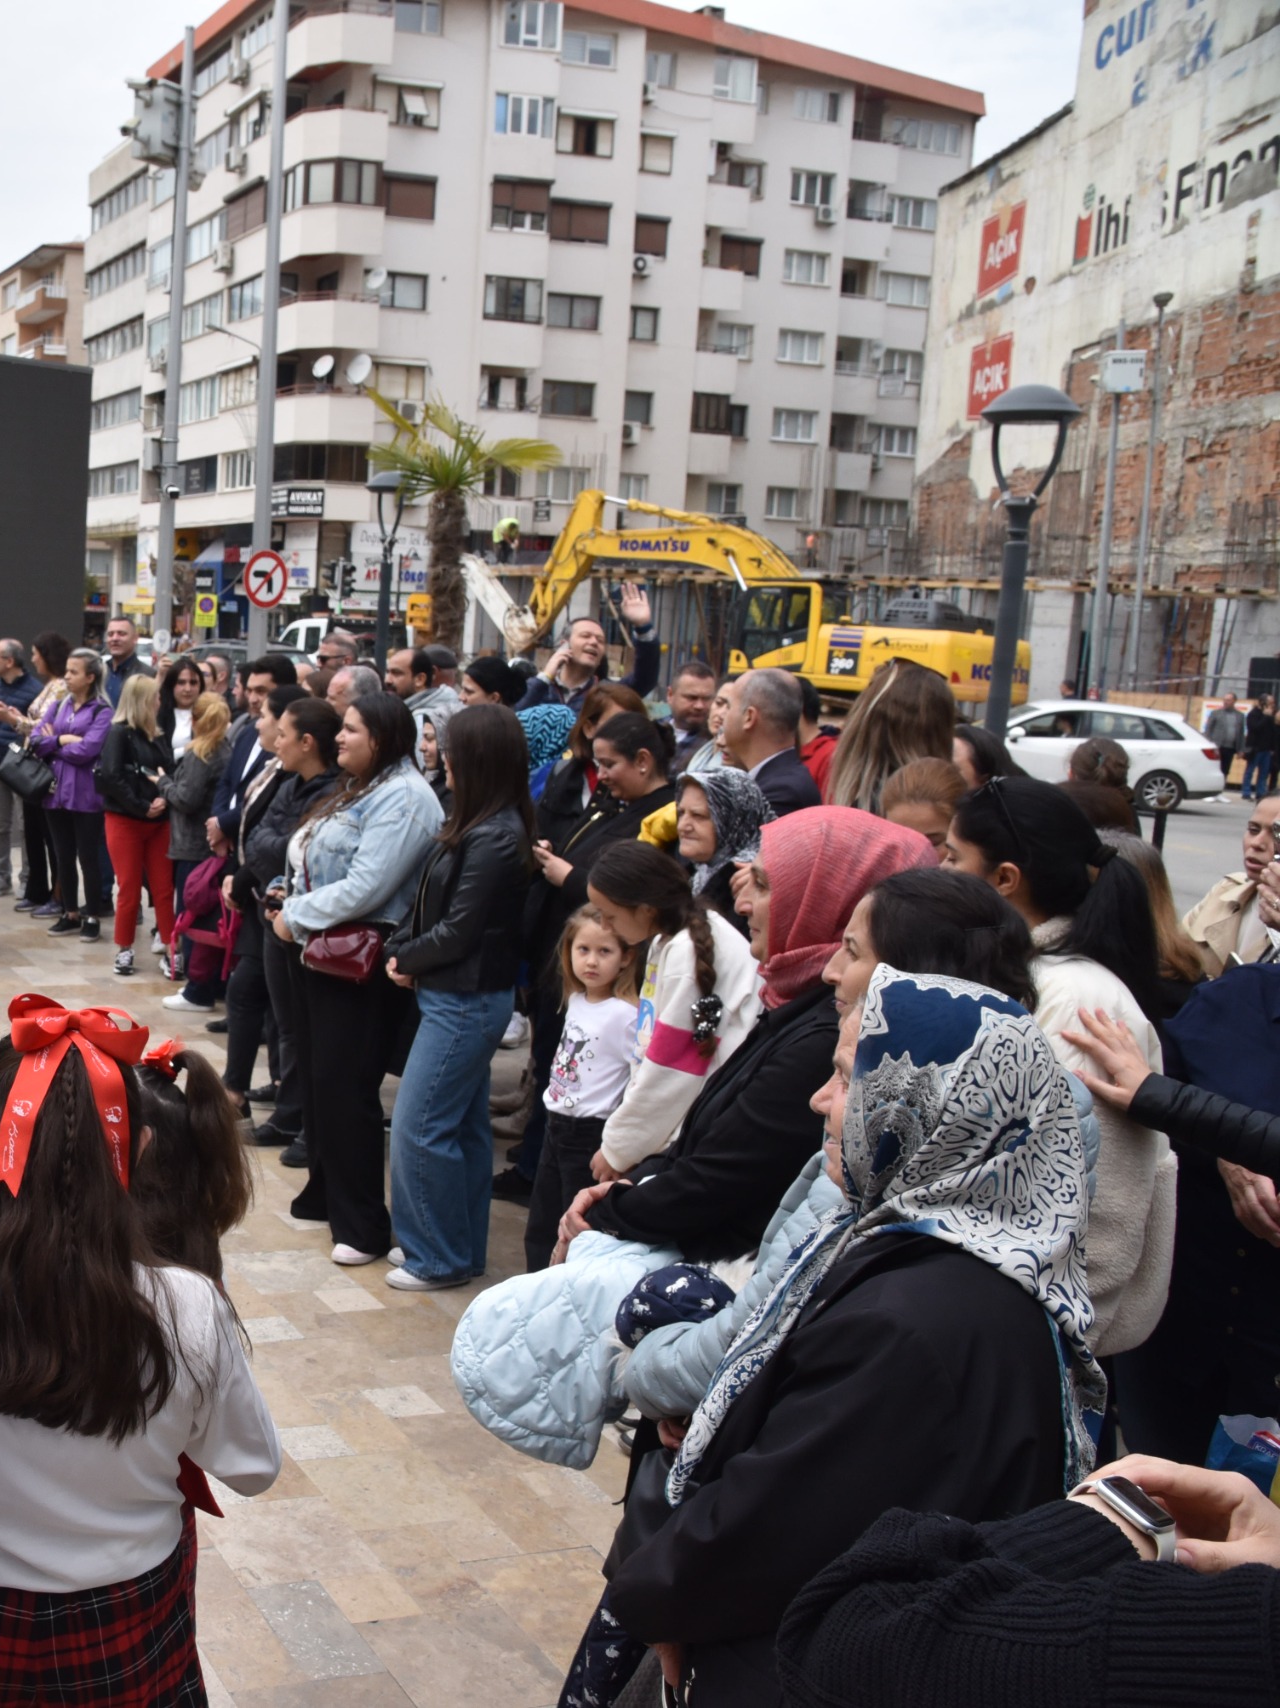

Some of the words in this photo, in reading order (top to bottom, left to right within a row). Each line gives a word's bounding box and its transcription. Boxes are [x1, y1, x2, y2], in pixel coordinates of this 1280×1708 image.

[984, 229, 1019, 271] AÇIK
[973, 362, 1005, 401] AÇIK
[618, 536, 690, 553] KOMATSU
[830, 657, 855, 670] 360
